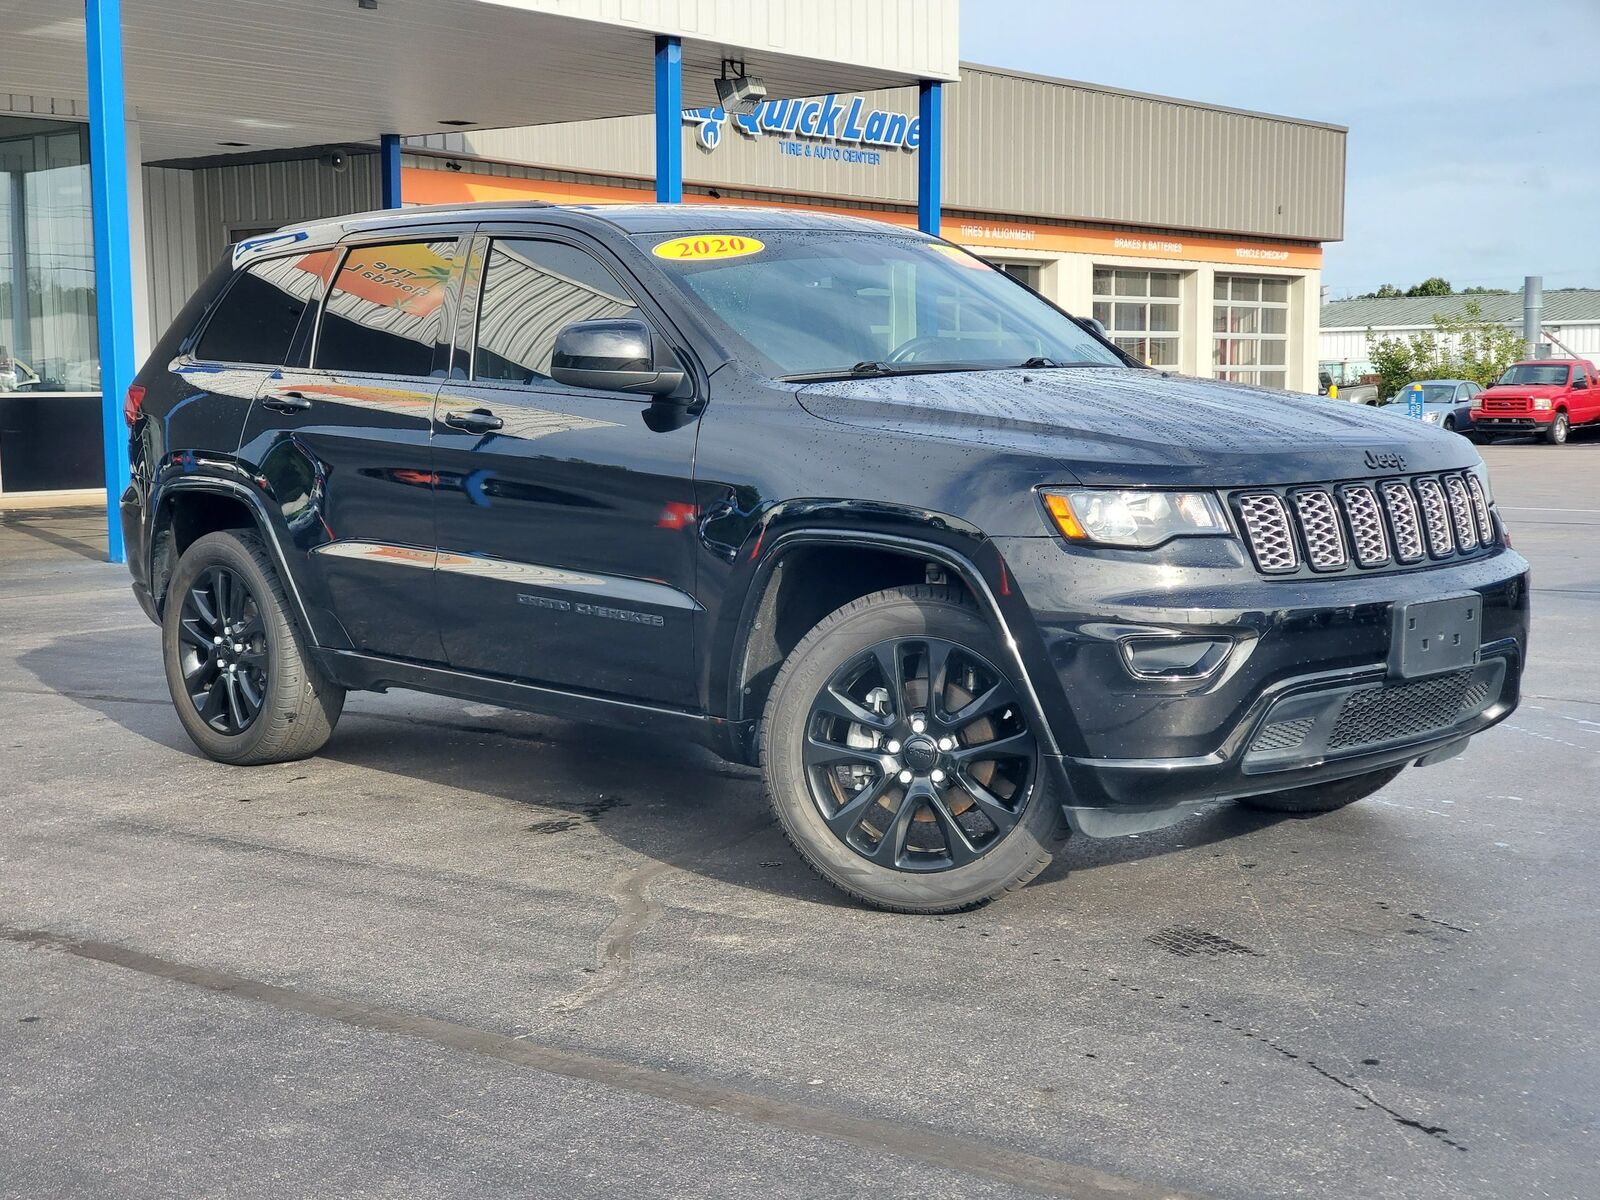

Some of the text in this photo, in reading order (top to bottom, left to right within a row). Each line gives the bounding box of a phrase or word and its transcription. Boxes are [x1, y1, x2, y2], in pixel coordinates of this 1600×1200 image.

[842, 96, 920, 149] Lane
[779, 140, 880, 165] TIRE & AUTO CENTER
[960, 225, 1036, 241] TIRES & ALIGNMENT
[676, 238, 746, 257] 2020
[1114, 237, 1183, 253] BRAKES & BATTERIES
[1235, 248, 1260, 259] VEHICLE
[1363, 450, 1407, 472] Jeep
[516, 593, 665, 627] GRAND CHEROKEE
